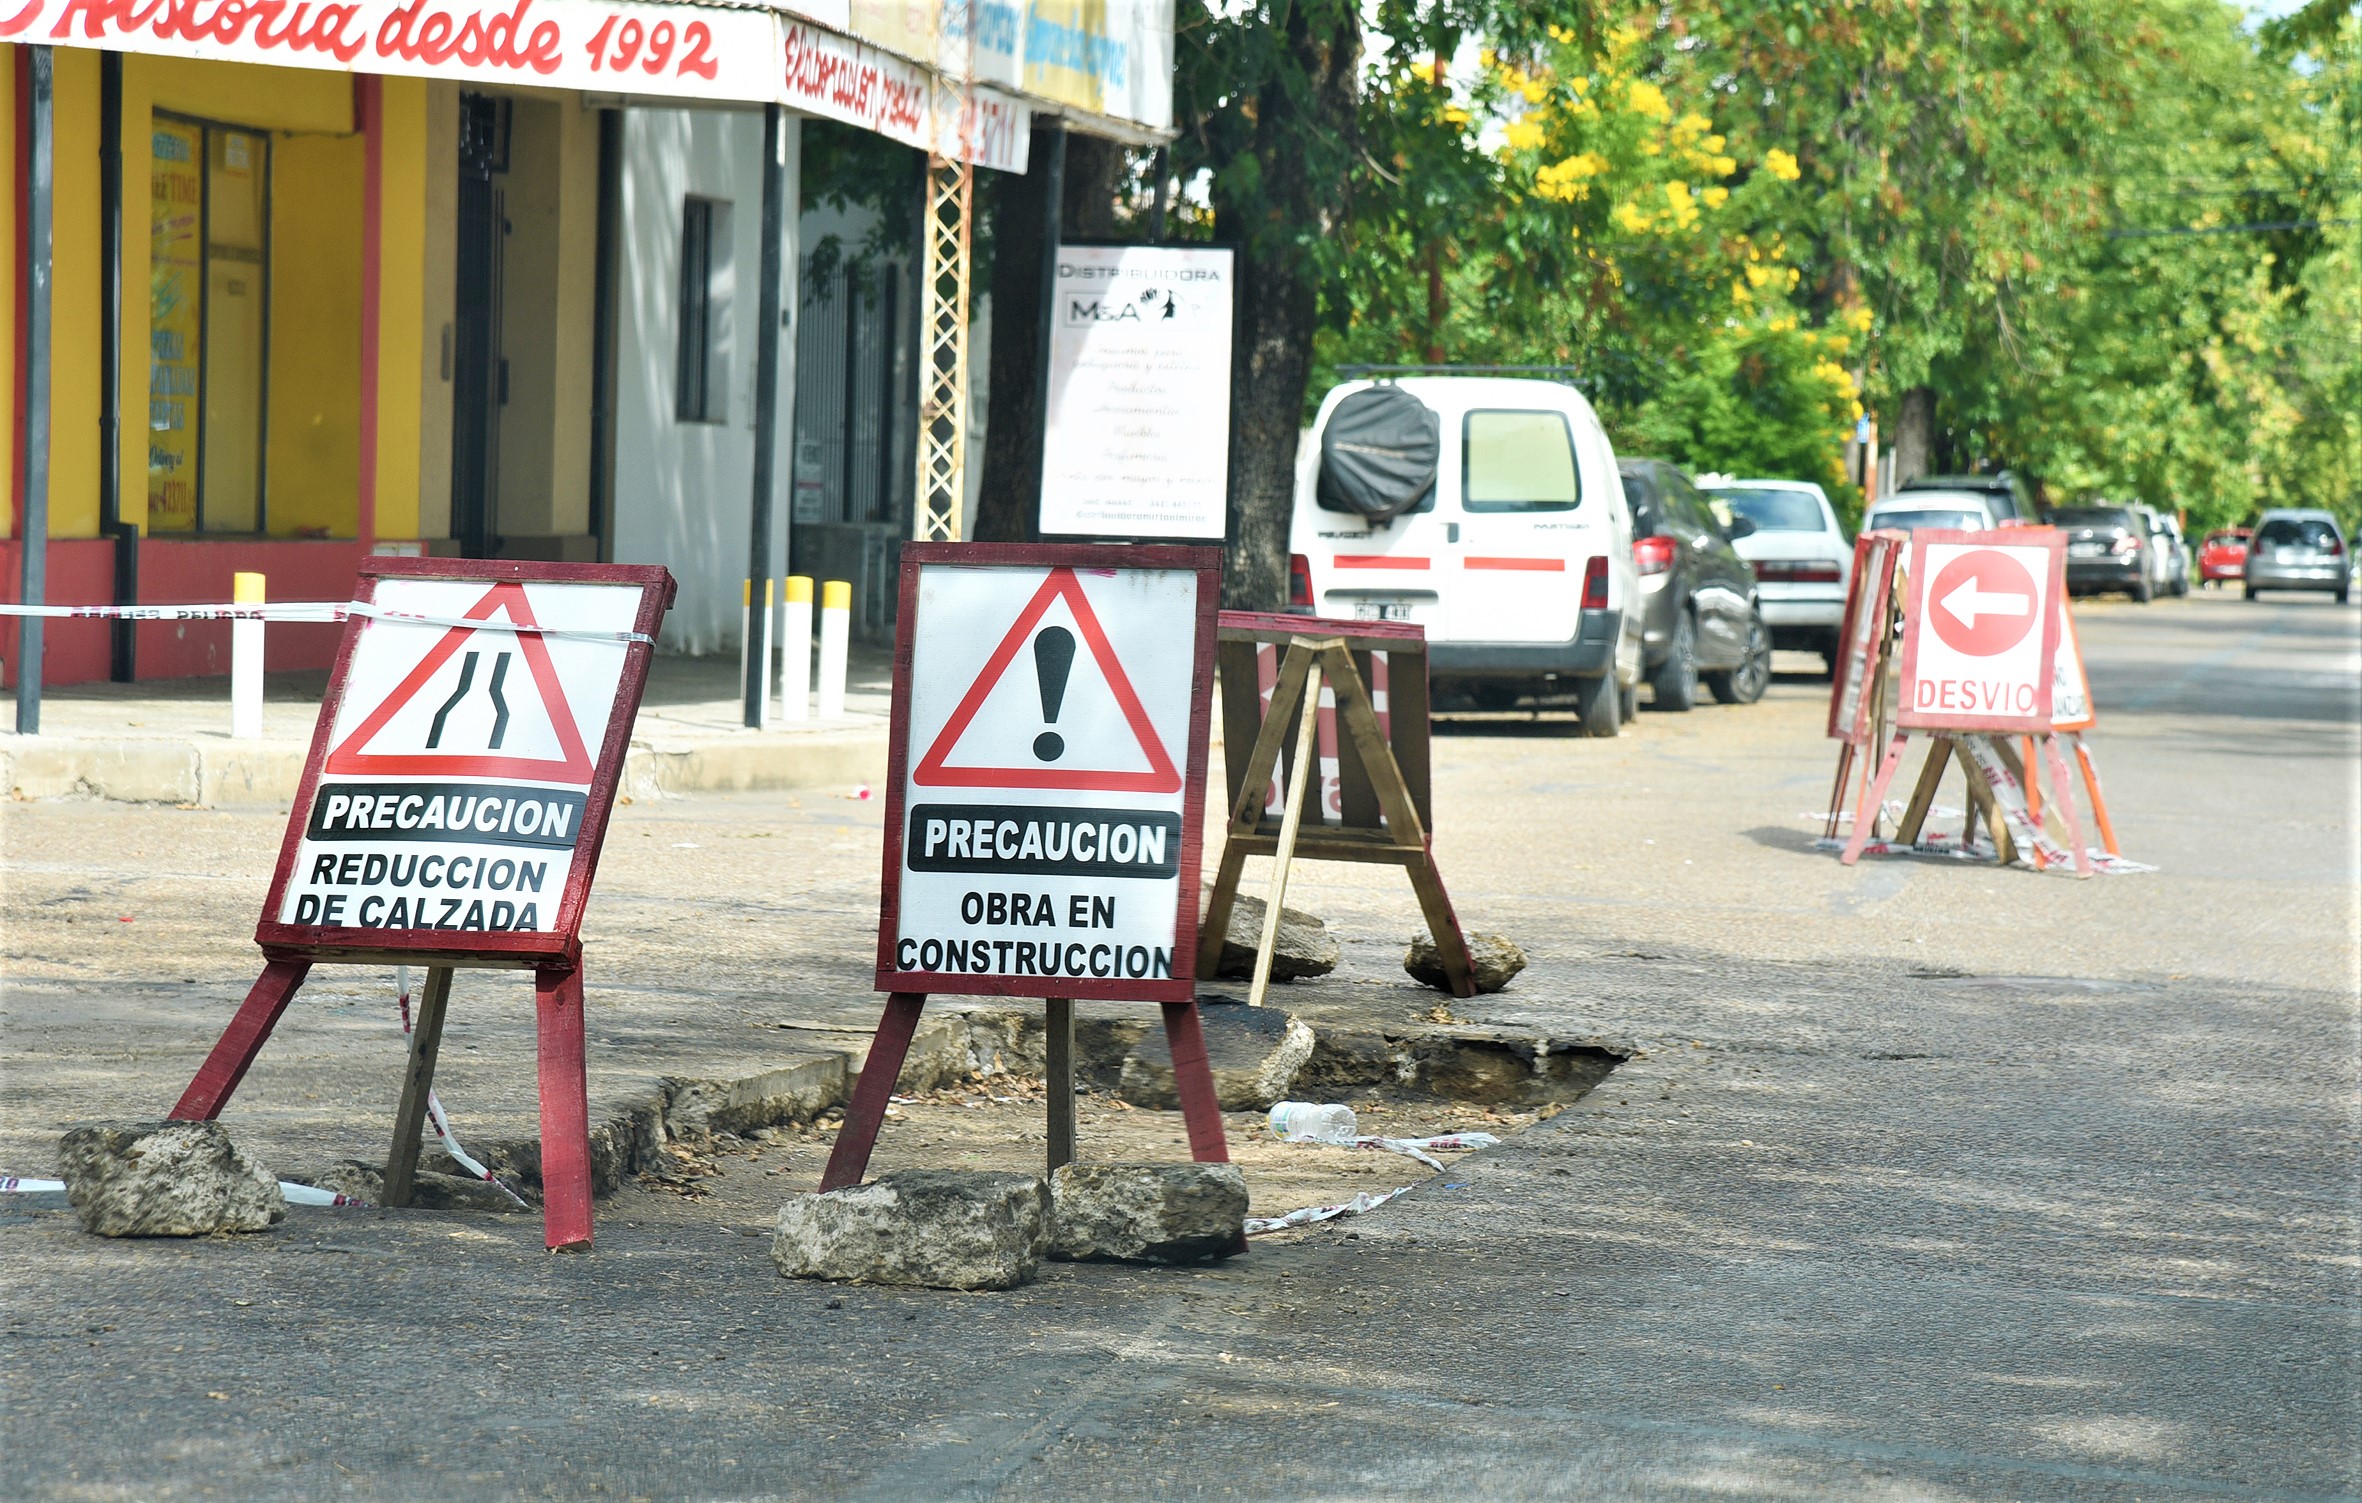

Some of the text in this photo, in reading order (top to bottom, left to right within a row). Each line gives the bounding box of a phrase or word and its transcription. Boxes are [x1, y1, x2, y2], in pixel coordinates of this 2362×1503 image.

[376, 0, 562, 74] desde
[586, 16, 718, 79] 1992
[1918, 679, 2035, 712] DESVIO
[323, 795, 574, 838] PRECAUCION
[926, 820, 1167, 865] PRECAUCION
[310, 854, 547, 893] REDUCCION
[294, 894, 538, 932] DE CALZADA
[962, 892, 1115, 928] OBRA EN
[897, 938, 1174, 978] CONSTRUCCION
